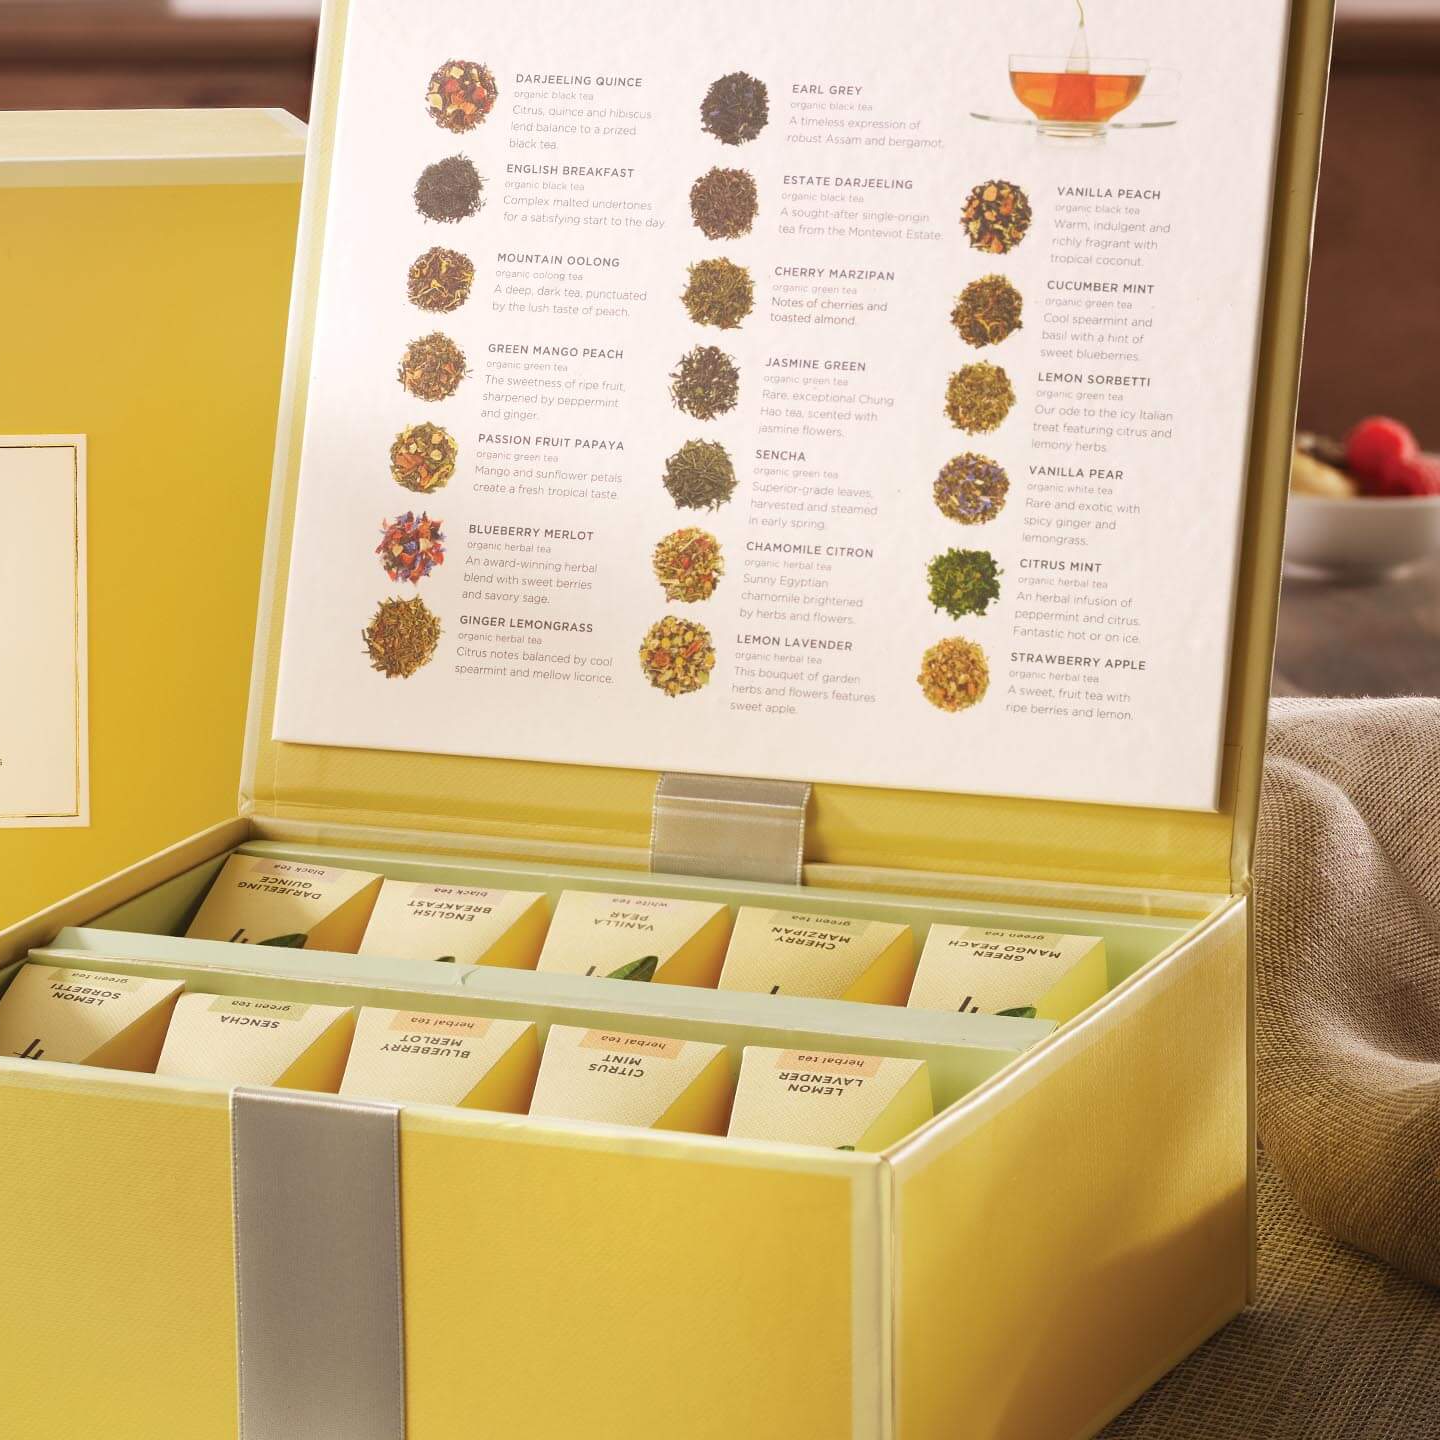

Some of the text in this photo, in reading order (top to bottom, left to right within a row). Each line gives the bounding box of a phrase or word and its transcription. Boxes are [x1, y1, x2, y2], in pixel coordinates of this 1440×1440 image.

[516, 74, 643, 87] DARJEELING QUINCE
[792, 84, 863, 96] EARL GREY
[507, 164, 635, 178] ENGLISH BREAKFAST
[783, 175, 913, 189] ESTATE DARJEELING
[1057, 187, 1161, 200] VANILLA PEACH
[498, 253, 620, 267] MOUNTAIN OOLONG
[774, 267, 895, 281] CHERRY MARZIPAN
[1047, 281, 1154, 294] CUCUMBER MINT
[772, 297, 888, 312] Notes of cherries and
[770, 313, 811, 323] toasted
[488, 343, 623, 359] GREEN MANGO PEACH
[766, 358, 866, 371] JASMINE GREEN
[1038, 373, 1150, 387] LEMON SORBETTI
[478, 433, 624, 450] PASSION FRUIT PAPAYA
[755, 449, 806, 462] SENCHA
[1029, 466, 1123, 480] VANILLA PEAR
[469, 524, 593, 540] BLUEBERRY MERLOT
[746, 541, 873, 558] CHAMOMILE CITRON
[465, 555, 597, 573] An award-winning herbal
[1020, 559, 1102, 573] CITRUS MINT
[463, 572, 592, 590] blend with sweet berries
[462, 589, 550, 606] and savory sage.
[460, 615, 593, 632] GINGER LEMONGRASS
[737, 634, 853, 651] LEMON LAVENDER
[456, 646, 613, 667] Citrus notes balanced by cool
[1011, 652, 1146, 671] STRAWBERRY APPLE
[455, 664, 614, 684] spearmint and mellow licorice.
[1008, 686, 1016, 694] A
[1059, 688, 1080, 699] fruit
[1085, 691, 1103, 701] tea
[1107, 692, 1131, 702] with
[1006, 704, 1027, 714] ripe
[1030, 705, 1068, 716] berries
[1072, 707, 1093, 718] and
[260, 876, 312, 889] QUINCE
[238, 881, 322, 900] DARJEELING
[457, 889, 488, 897] black
[407, 900, 493, 914] BREAKFAST
[413, 909, 475, 922] ENGLISH
[610, 912, 649, 921] PEAR
[815, 918, 851, 927] green
[594, 918, 654, 931] VANILLA
[771, 927, 851, 944] MARZIPAN
[1007, 933, 1045, 941] green
[776, 936, 836, 950] CHERRY
[948, 940, 1062, 959] MANGO PEACH
[973, 950, 1024, 962] GREEN
[50, 983, 121, 1000] SORBETTI
[52, 992, 105, 1006] LEMON
[254, 1003, 291, 1012] green
[220, 1015, 281, 1029] SENCHA
[411, 1016, 475, 1029] herbal tea
[400, 1035, 463, 1046] MERLOT
[625, 1038, 666, 1050] herbal
[380, 1043, 471, 1059] BLUEBERRY
[602, 1054, 642, 1066] MINT
[822, 1058, 864, 1067] herbal
[588, 1063, 645, 1078] CITRUS
[779, 1072, 864, 1087] LAVENDER
[788, 1083, 844, 1096] LEMON
